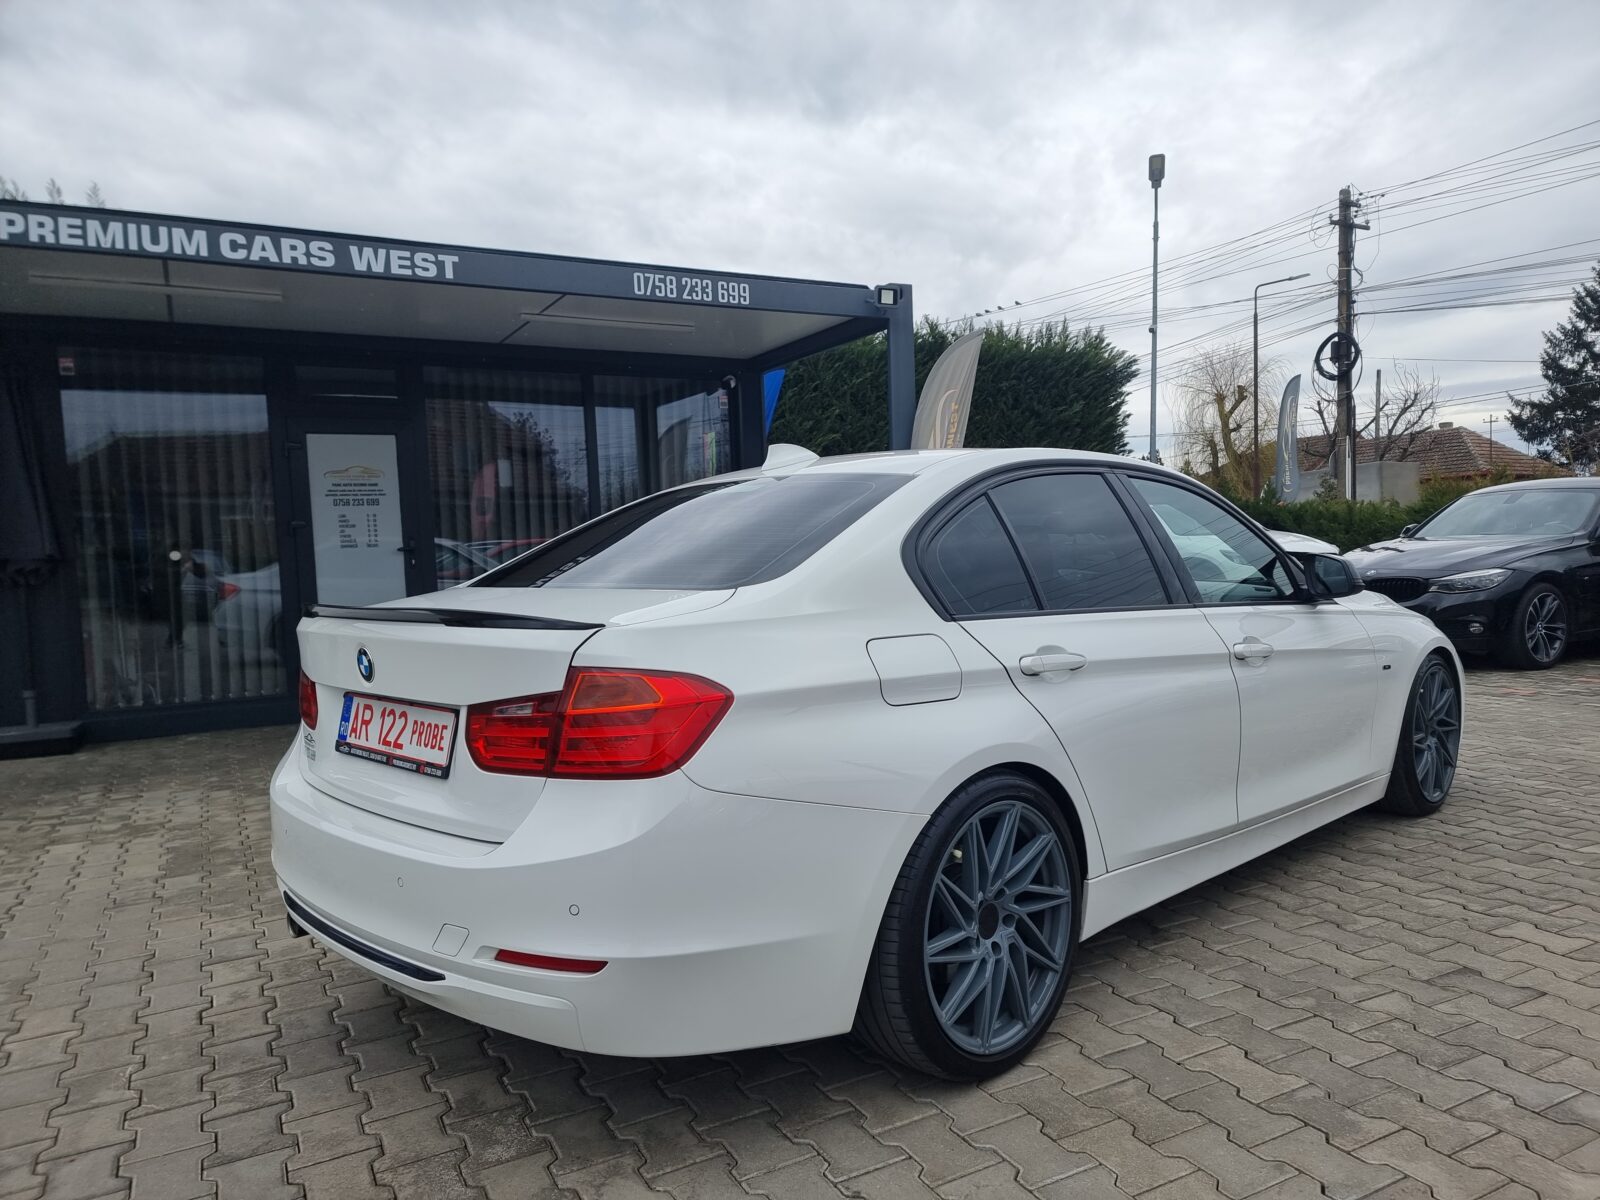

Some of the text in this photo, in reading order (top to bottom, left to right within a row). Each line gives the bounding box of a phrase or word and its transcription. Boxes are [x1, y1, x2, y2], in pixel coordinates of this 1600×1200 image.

[0, 211, 459, 279] PREMIUM CARS WEST
[633, 272, 750, 305] 0758 233 699
[352, 498, 365, 507] 233
[366, 498, 380, 507] 699
[340, 721, 349, 735] RO
[350, 703, 448, 751] AR 122 PROBE
